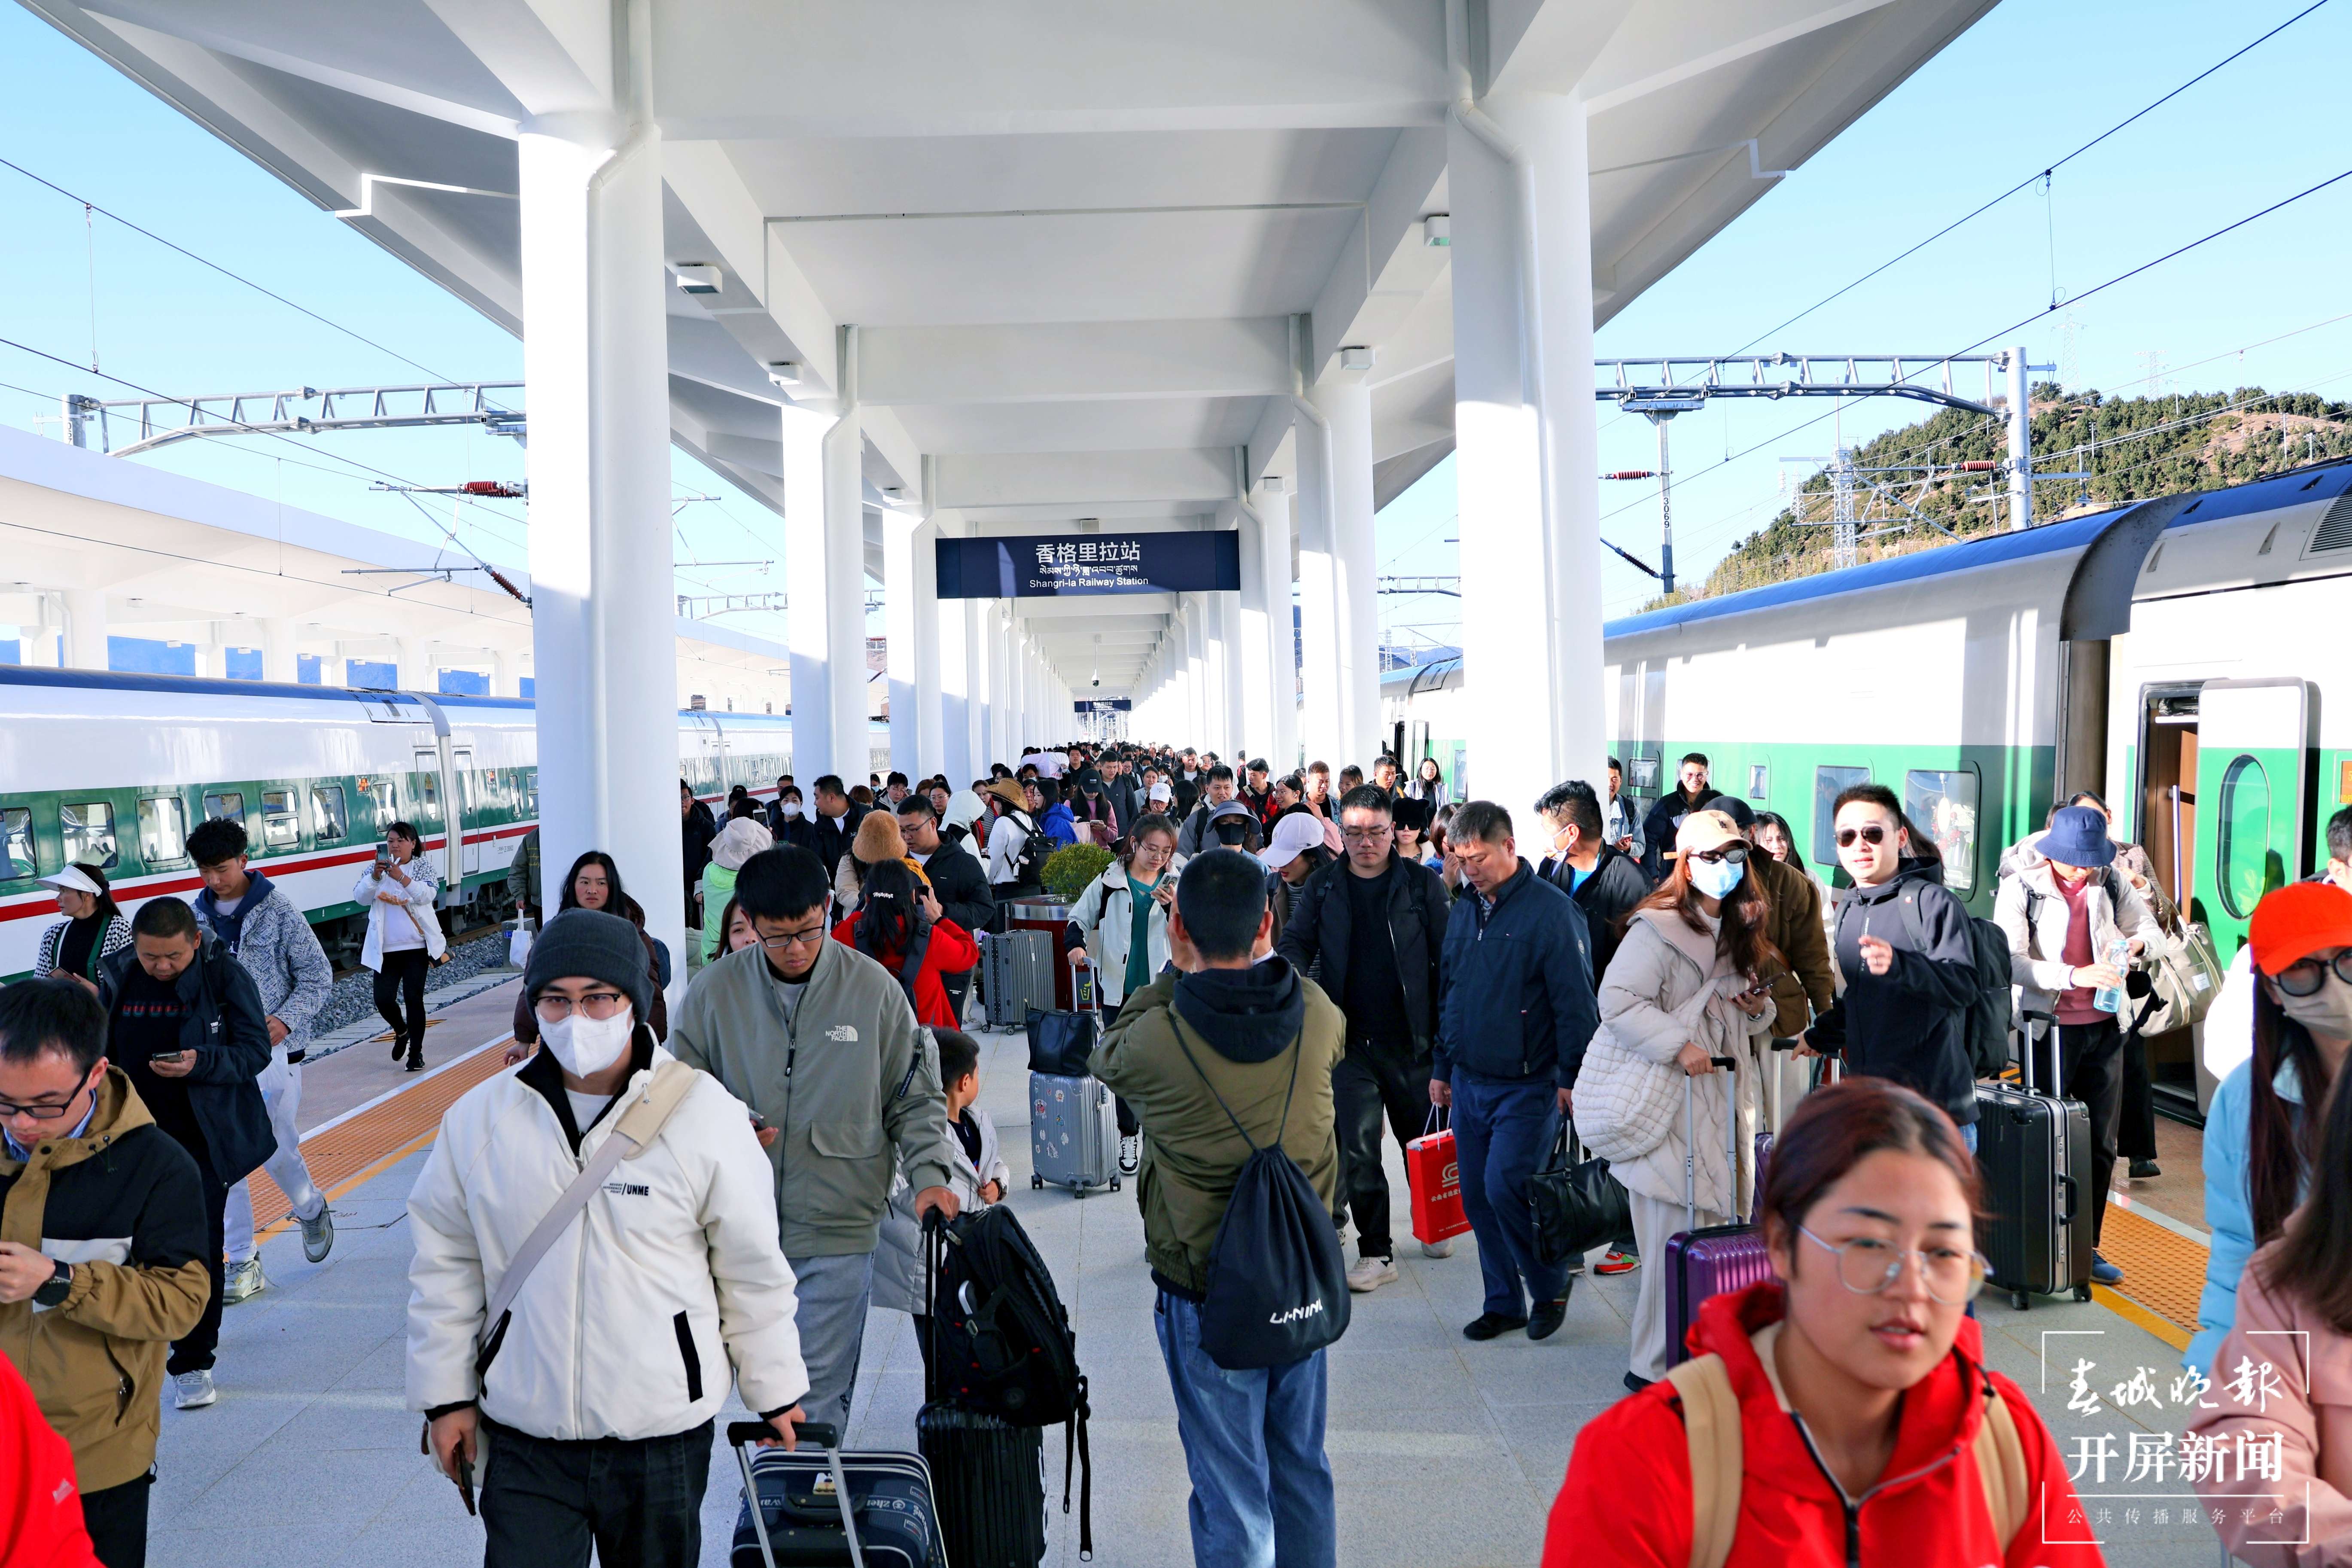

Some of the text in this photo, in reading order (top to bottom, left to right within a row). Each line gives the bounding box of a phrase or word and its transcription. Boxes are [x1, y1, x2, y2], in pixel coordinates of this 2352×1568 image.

[1036, 541, 1141, 563] 香格里拉站
[1030, 577, 1148, 589] Shangri-la Railway Station
